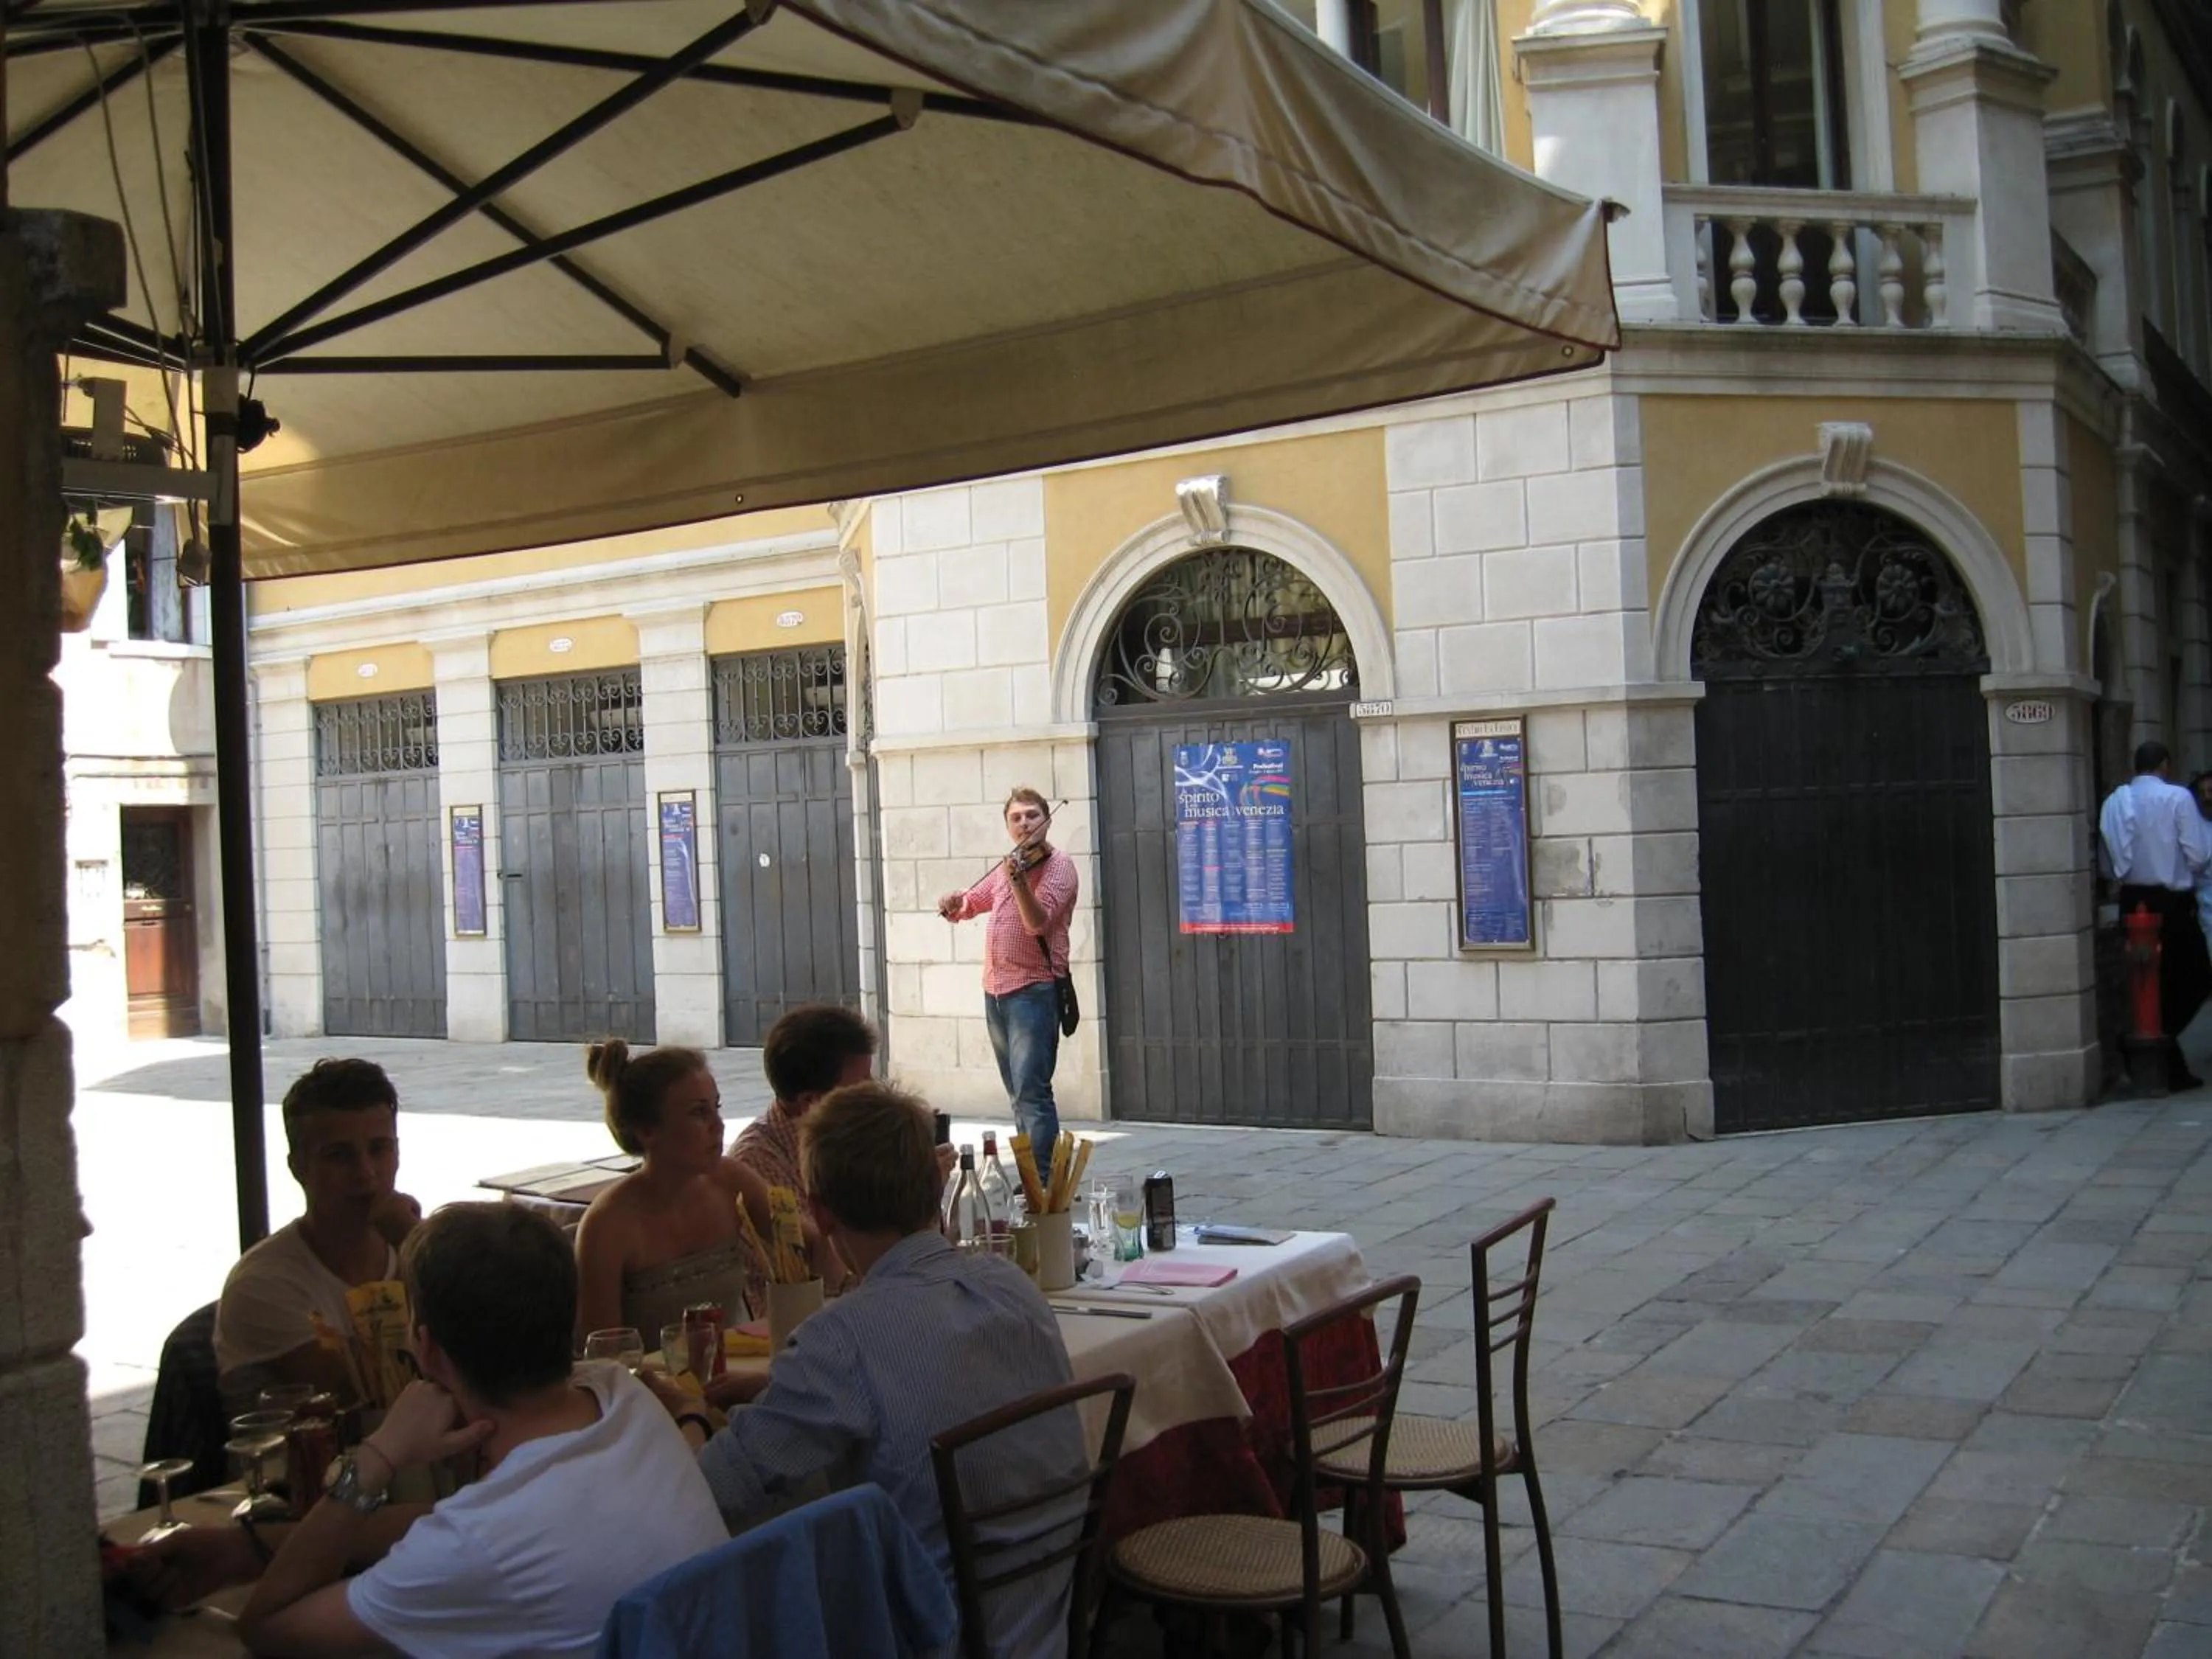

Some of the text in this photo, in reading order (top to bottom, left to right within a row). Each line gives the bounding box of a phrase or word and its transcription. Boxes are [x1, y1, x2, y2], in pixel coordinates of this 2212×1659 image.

[2011, 704, 2053, 720] 5869
[1179, 788, 1220, 808] spirito
[1184, 804, 1284, 818] musica venezia
